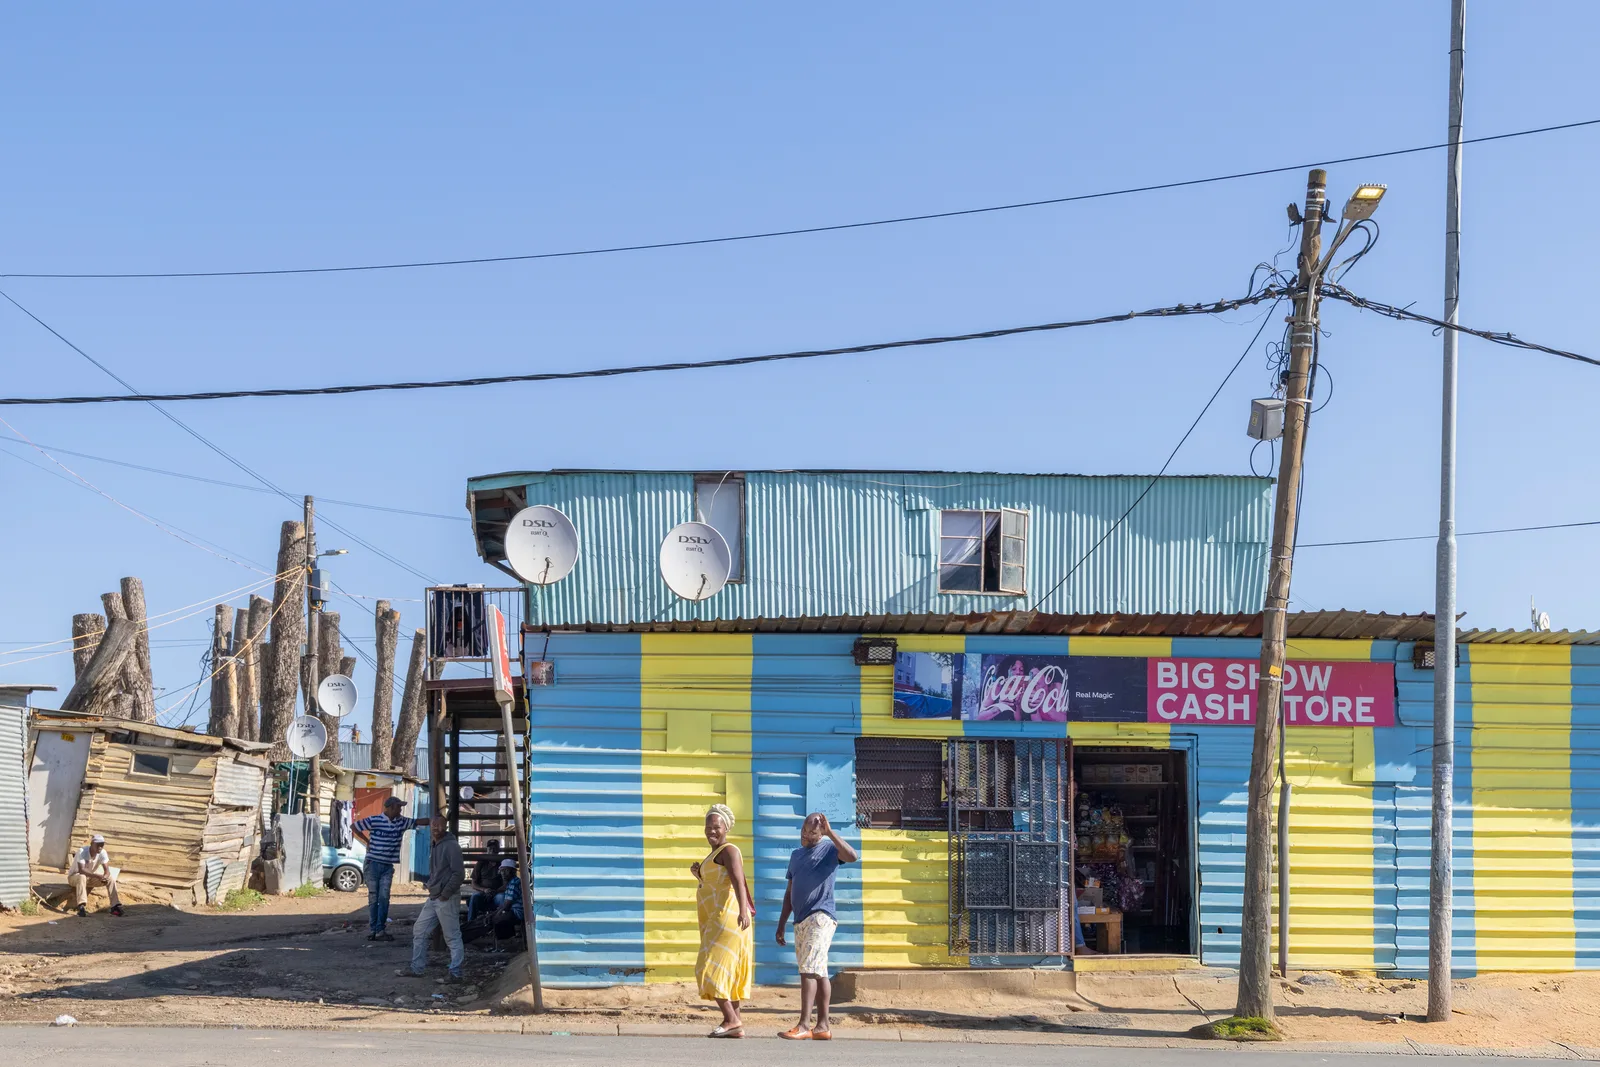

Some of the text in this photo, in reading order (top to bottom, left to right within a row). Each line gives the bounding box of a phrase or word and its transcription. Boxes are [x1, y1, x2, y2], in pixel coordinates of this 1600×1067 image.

[523, 520, 558, 528] DStv
[678, 535, 713, 545] DStv
[1157, 662, 1215, 690] BIG
[979, 664, 1070, 713] Coca-Cola
[1092, 691, 1114, 700] Magic
[1156, 692, 1376, 723] CASH TORE
